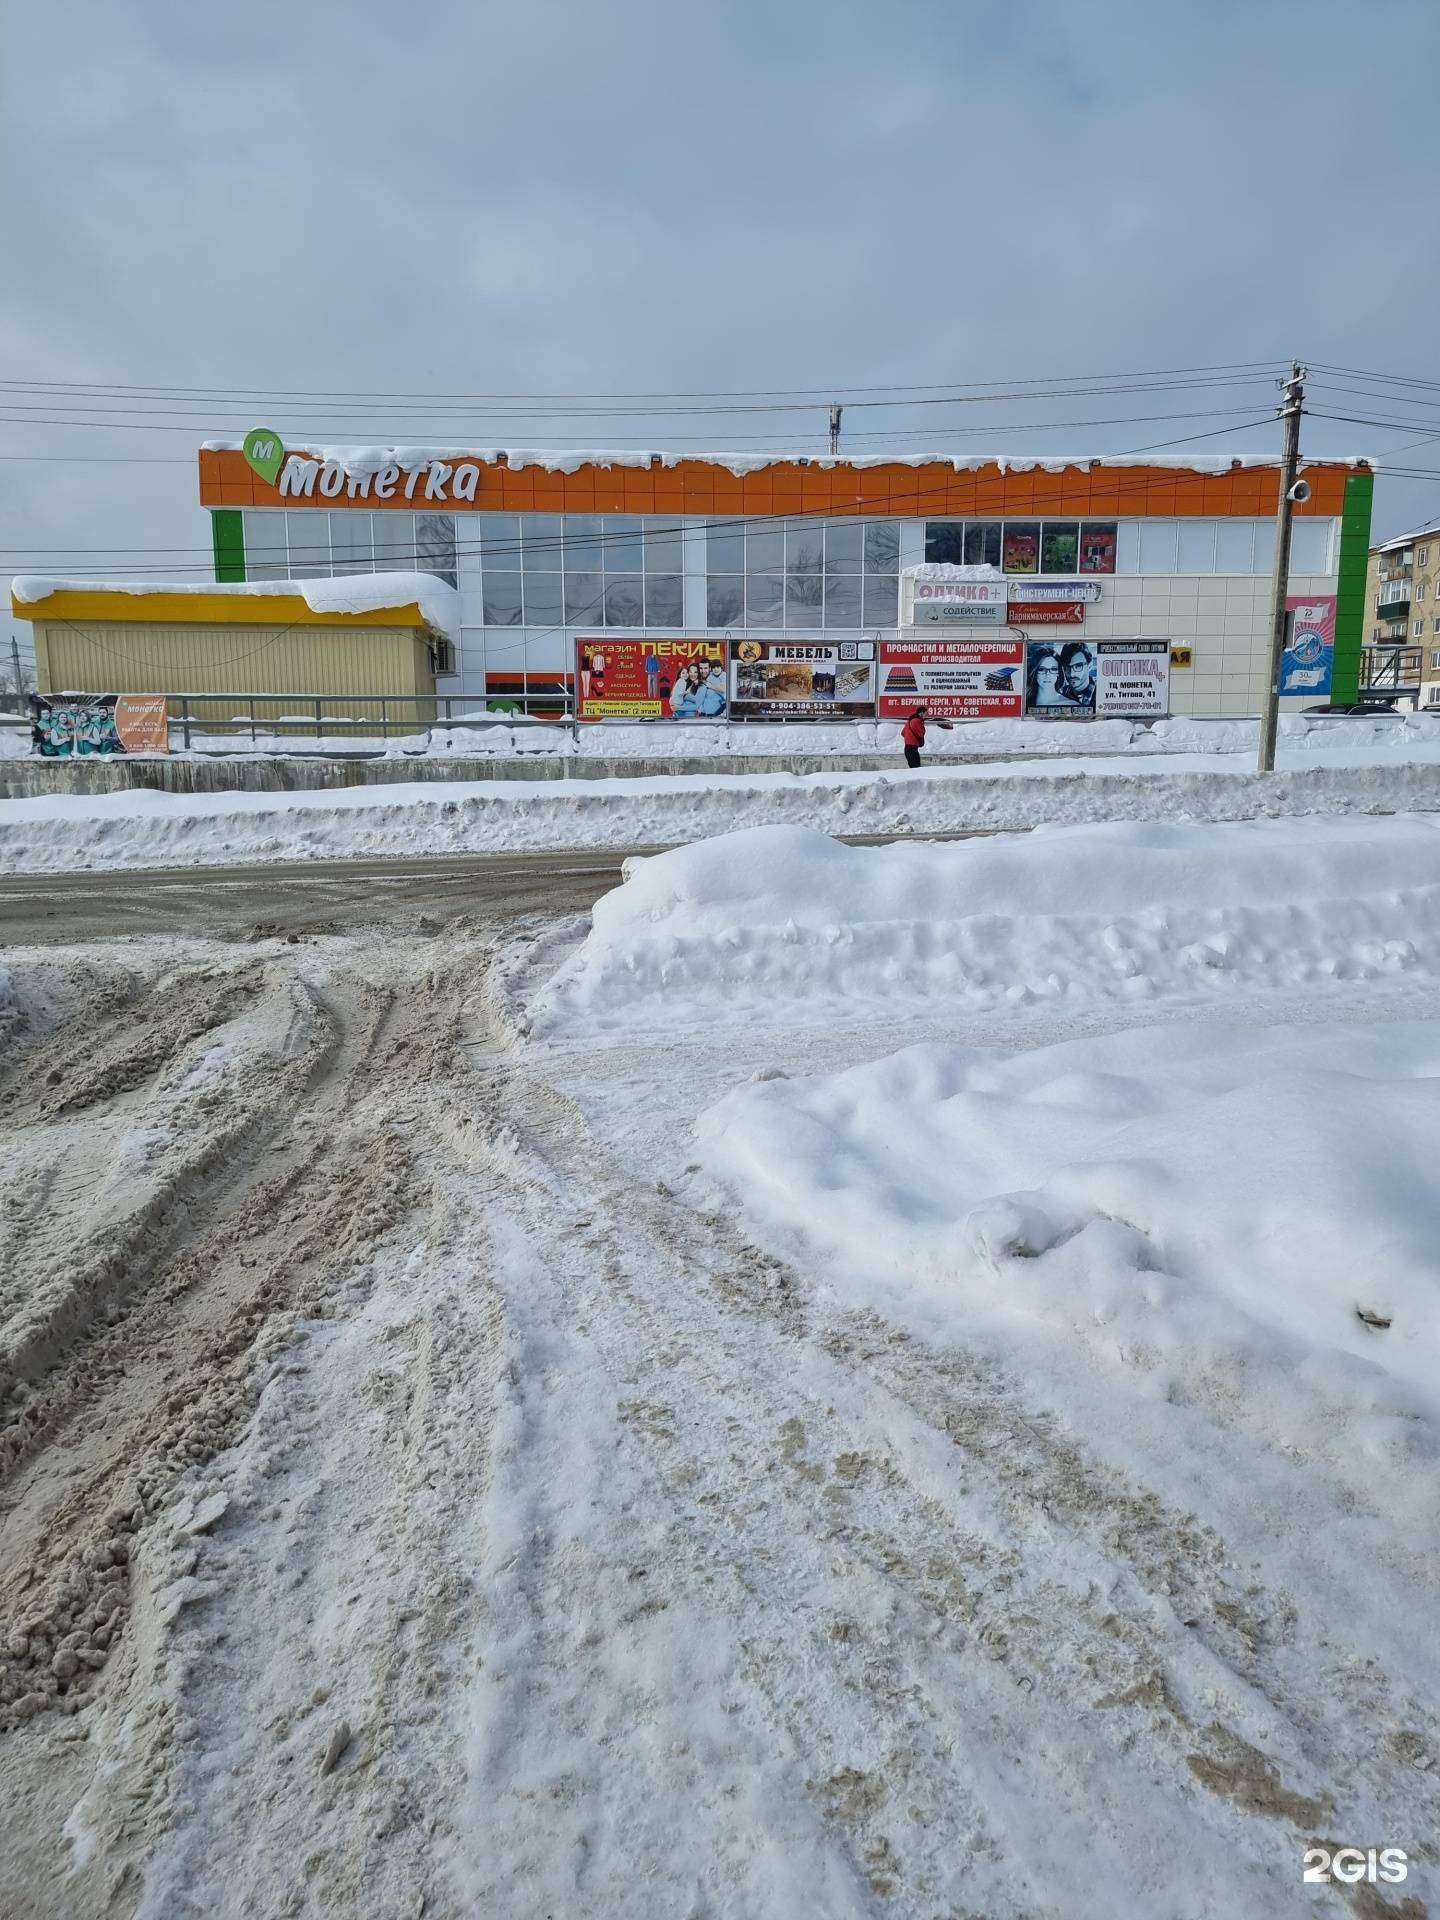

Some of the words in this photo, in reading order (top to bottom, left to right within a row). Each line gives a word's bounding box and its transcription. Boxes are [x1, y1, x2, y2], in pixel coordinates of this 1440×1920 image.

[919, 584, 988, 600] ОПТИКА
[943, 606, 996, 615] СОДЕЙСТВИЕ
[640, 642, 720, 658] ПЕКИН
[775, 647, 833, 659] МЕБЕЛЬ
[887, 644, 937, 653] ПРОФНАСТИЛ
[939, 644, 944, 652] И
[946, 644, 1016, 654] МЕТАЛЛОЧЕРЕПИЦА
[930, 656, 981, 664] ПРОИЗВОДИТЕЛЯ
[901, 698, 929, 706] ВЕРХНИЕ
